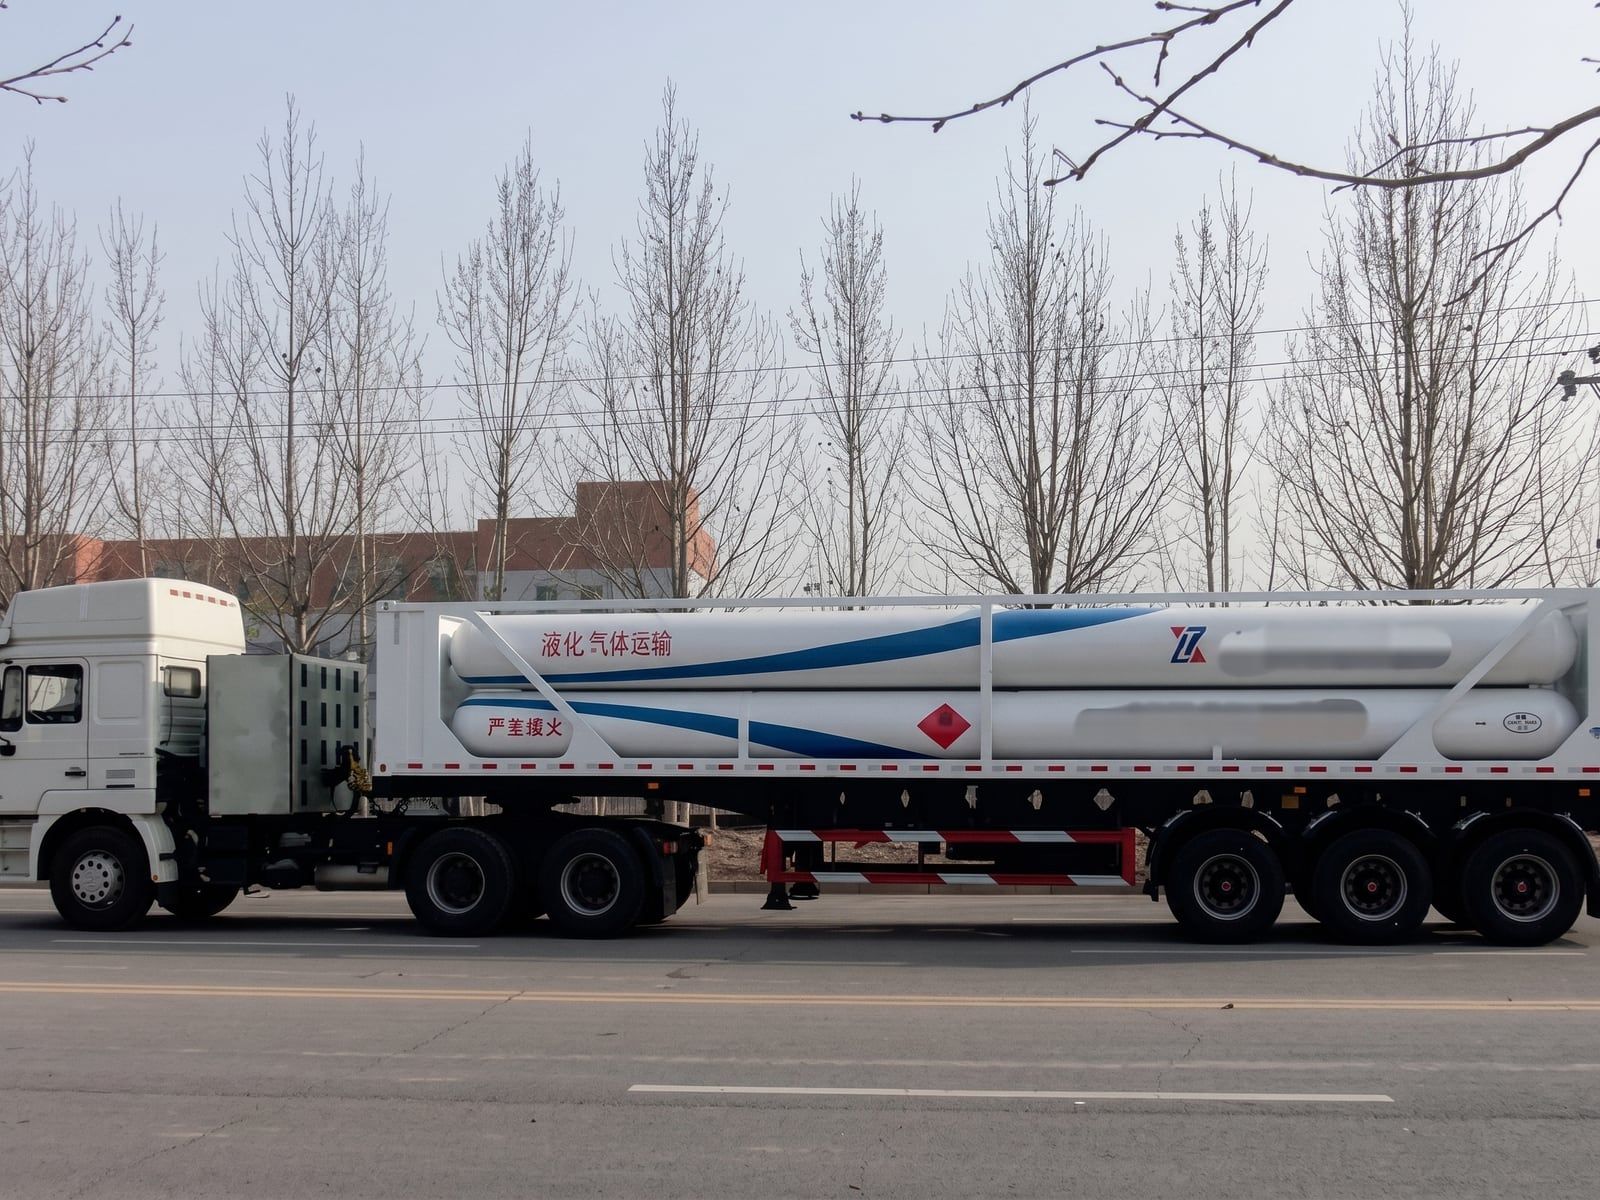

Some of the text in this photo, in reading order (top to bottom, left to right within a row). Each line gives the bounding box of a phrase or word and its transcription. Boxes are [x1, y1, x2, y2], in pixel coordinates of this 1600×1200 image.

[541, 630, 672, 657] 液化气体运输
